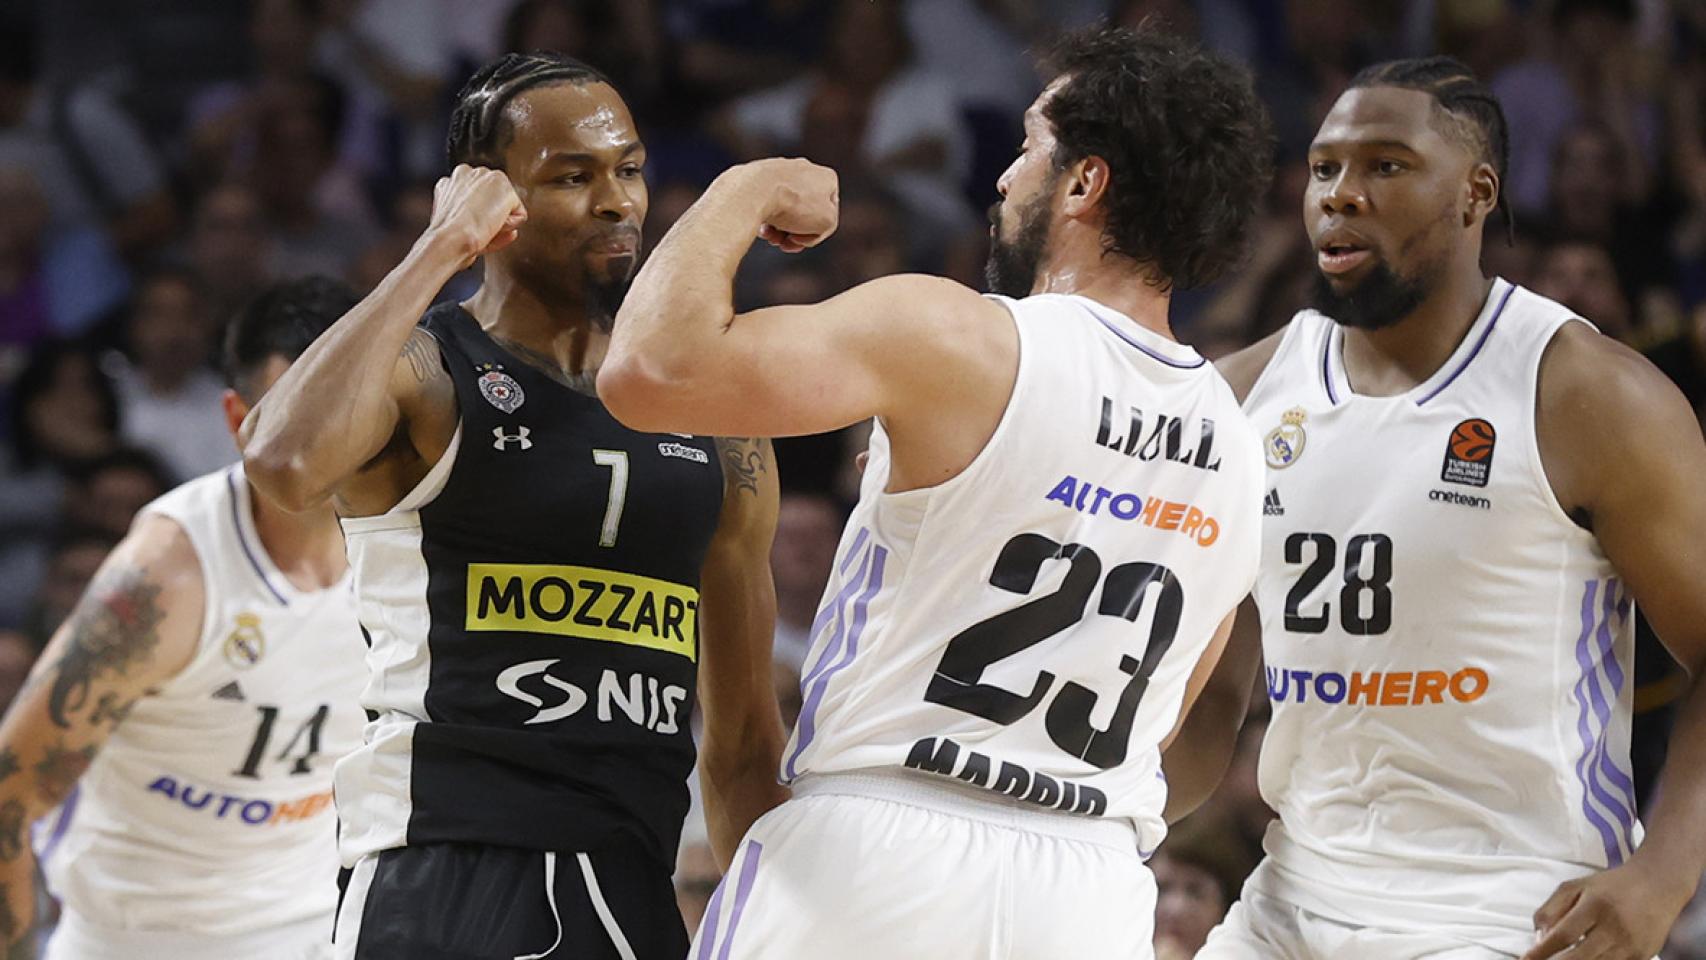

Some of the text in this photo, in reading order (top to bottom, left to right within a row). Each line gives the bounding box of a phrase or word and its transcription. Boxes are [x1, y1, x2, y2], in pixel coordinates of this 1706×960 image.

[592, 449, 629, 547] 7
[1284, 532, 1393, 635] 28
[924, 533, 1184, 770] 23
[1266, 666, 1489, 706] UTOHERO
[232, 705, 329, 779] 14
[597, 669, 687, 734] NIS
